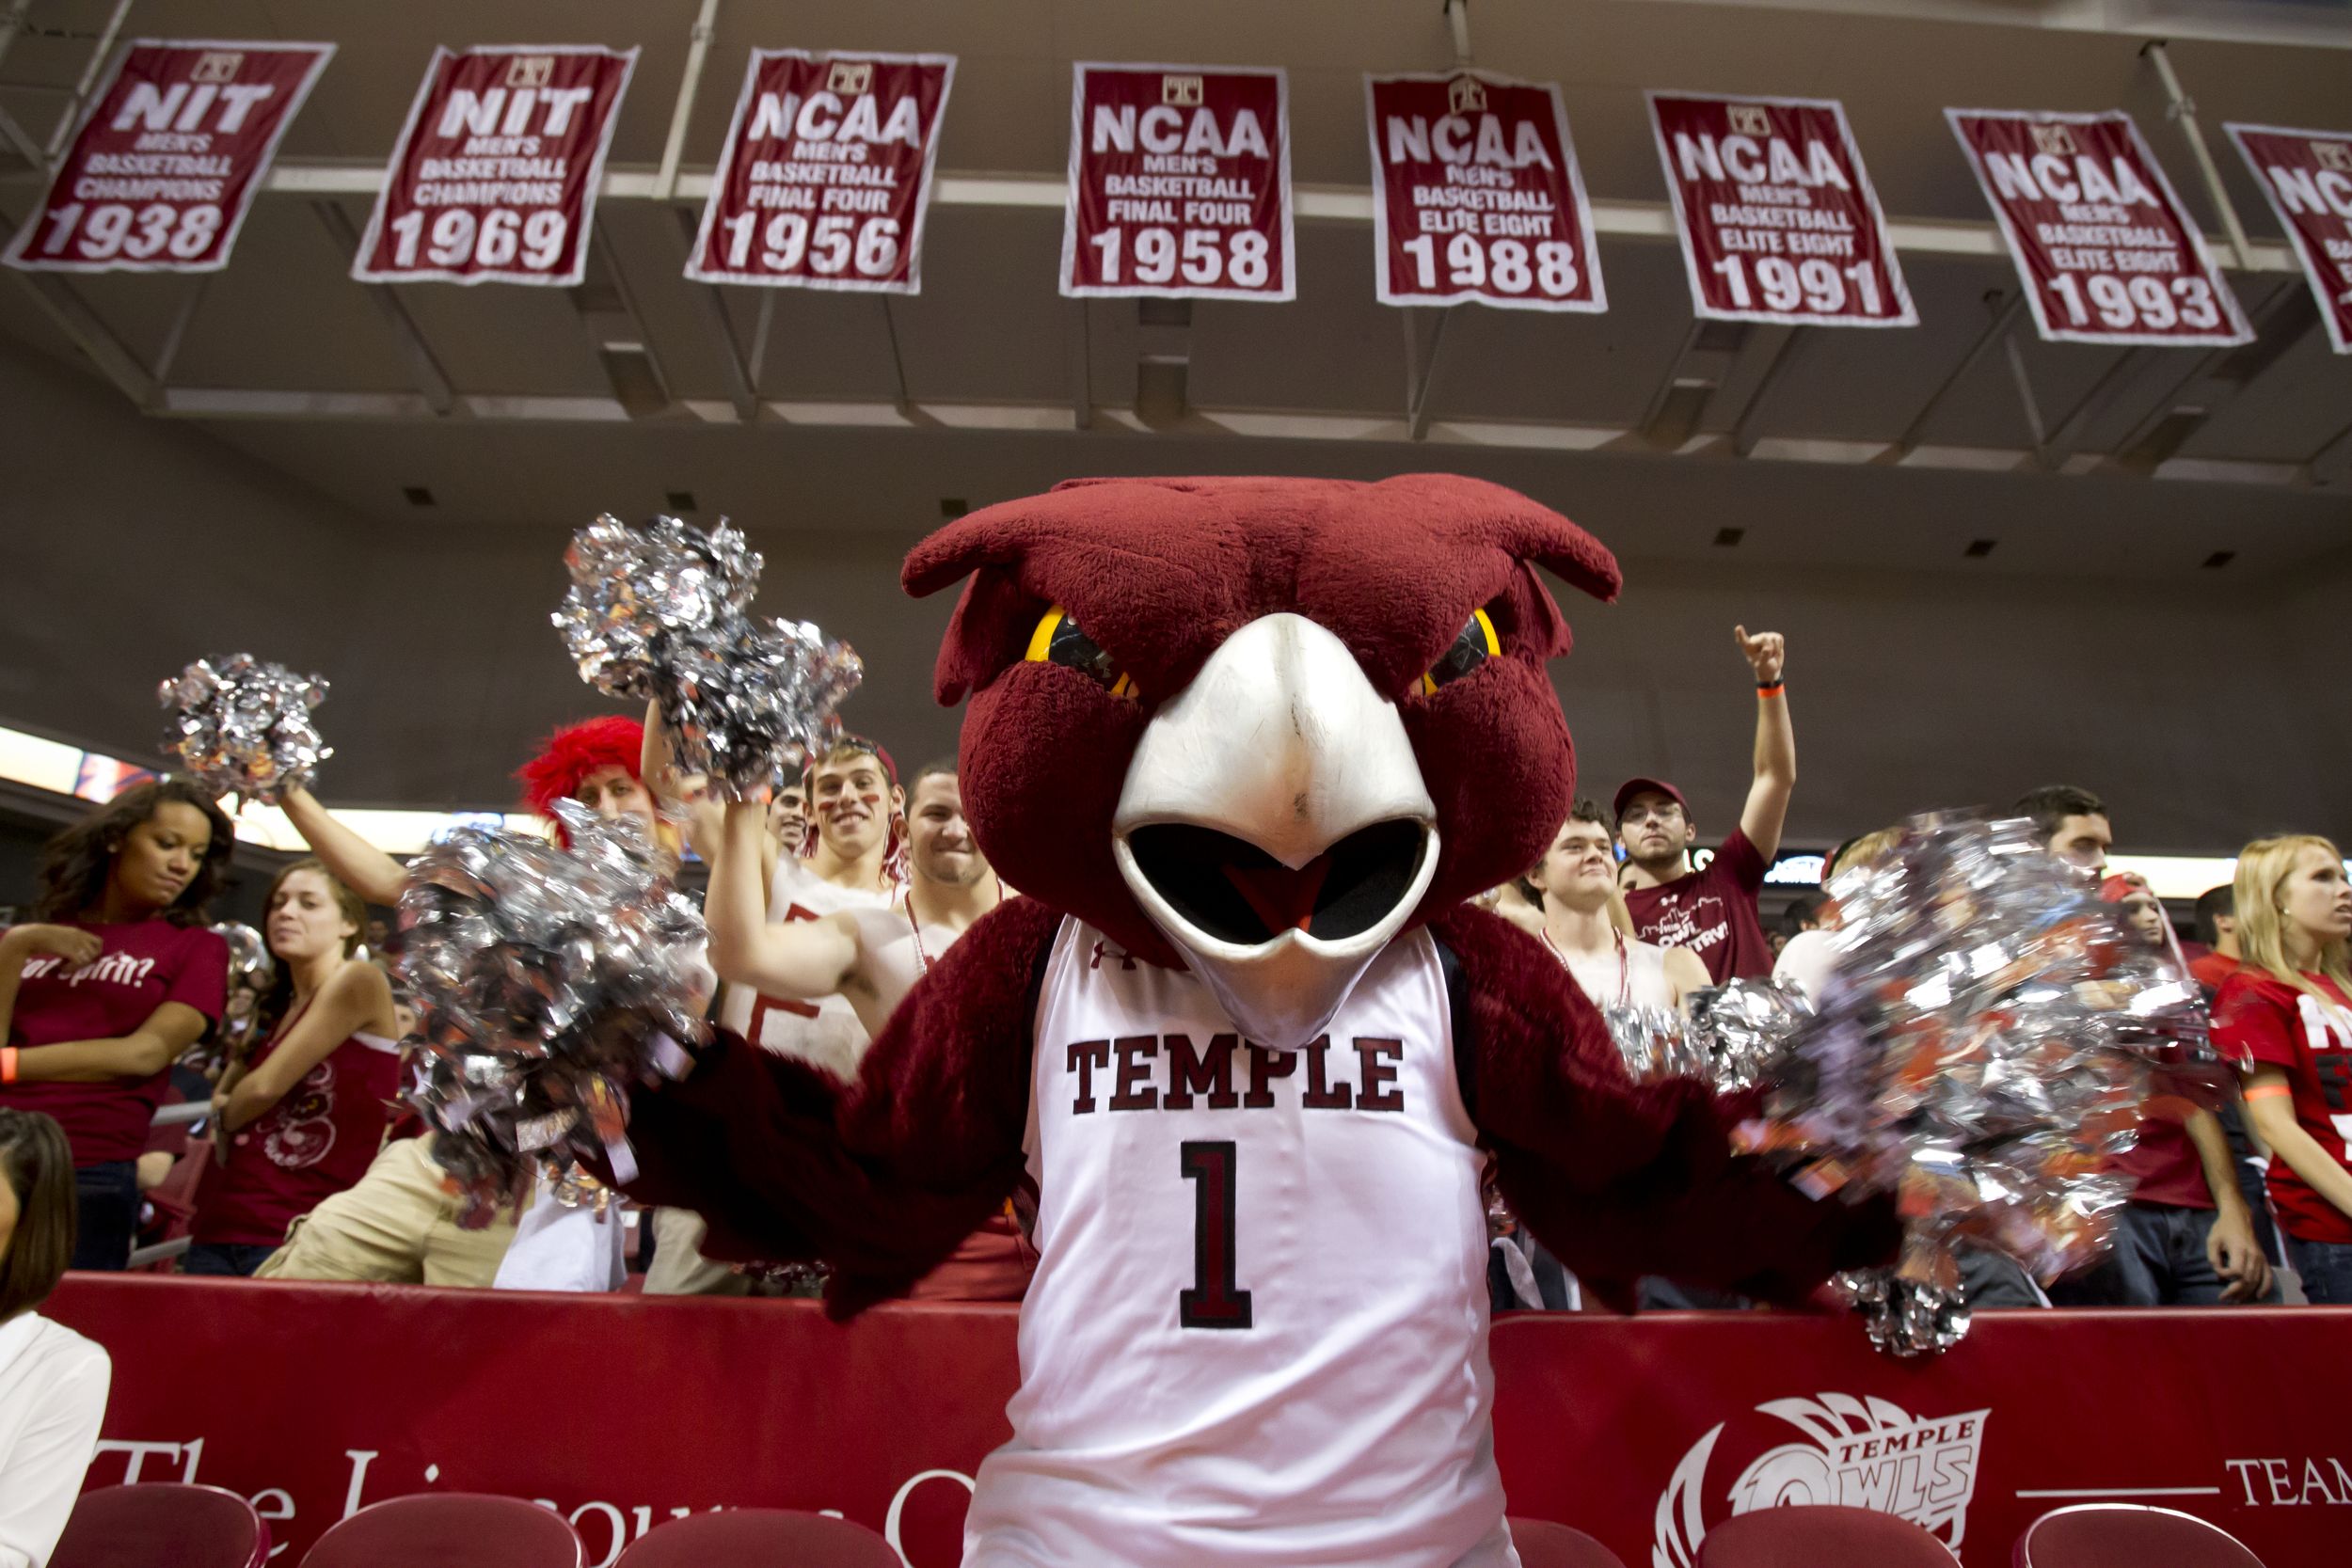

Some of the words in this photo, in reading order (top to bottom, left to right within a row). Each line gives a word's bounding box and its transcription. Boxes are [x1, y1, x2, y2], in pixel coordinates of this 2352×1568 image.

[111, 82, 275, 134] NIT
[437, 87, 593, 138] NIT
[747, 90, 921, 150] NCAA
[1092, 103, 1270, 159] NCAA
[84, 153, 232, 176] BASKETBALL
[1386, 113, 1555, 171] NCAA
[1675, 132, 1851, 192] NCAA
[74, 178, 224, 200] CHAMPIONS
[414, 182, 564, 205] CHAMPIONS
[420, 158, 566, 180] BASKETBALL
[749, 160, 898, 188] BASKETBALL
[1104, 174, 1256, 200] BASKETBALL
[1985, 152, 2160, 209] NCAA
[746, 184, 817, 210] FINAL
[821, 188, 891, 213] FOUR
[1106, 199, 1179, 223] FINAL
[1184, 201, 1252, 226] FOUR
[1413, 185, 1556, 211] BASKETBALL
[1419, 209, 1480, 234] ELITE
[1484, 214, 1554, 237] EIGHT
[1710, 203, 1854, 232] BASKETBALL
[43, 203, 223, 259] 1938
[391, 208, 567, 269] 1969
[723, 210, 900, 276] 1956
[1090, 226, 1269, 287] 1958
[1720, 229, 1785, 252] ELITE
[1788, 233, 1855, 256] EIGHT
[2037, 223, 2177, 248] BASKETBALL
[1403, 232, 1579, 296] 1988
[1713, 254, 1882, 314] 1991
[2049, 248, 2115, 270] ELITE
[2113, 251, 2181, 273] EIGHT
[2047, 273, 2219, 328] 1993
[1066, 1033, 1405, 1116] TEMPLE
[1180, 1140, 1252, 1329] 1
[1839, 1418, 1976, 1465] TEMPLE
